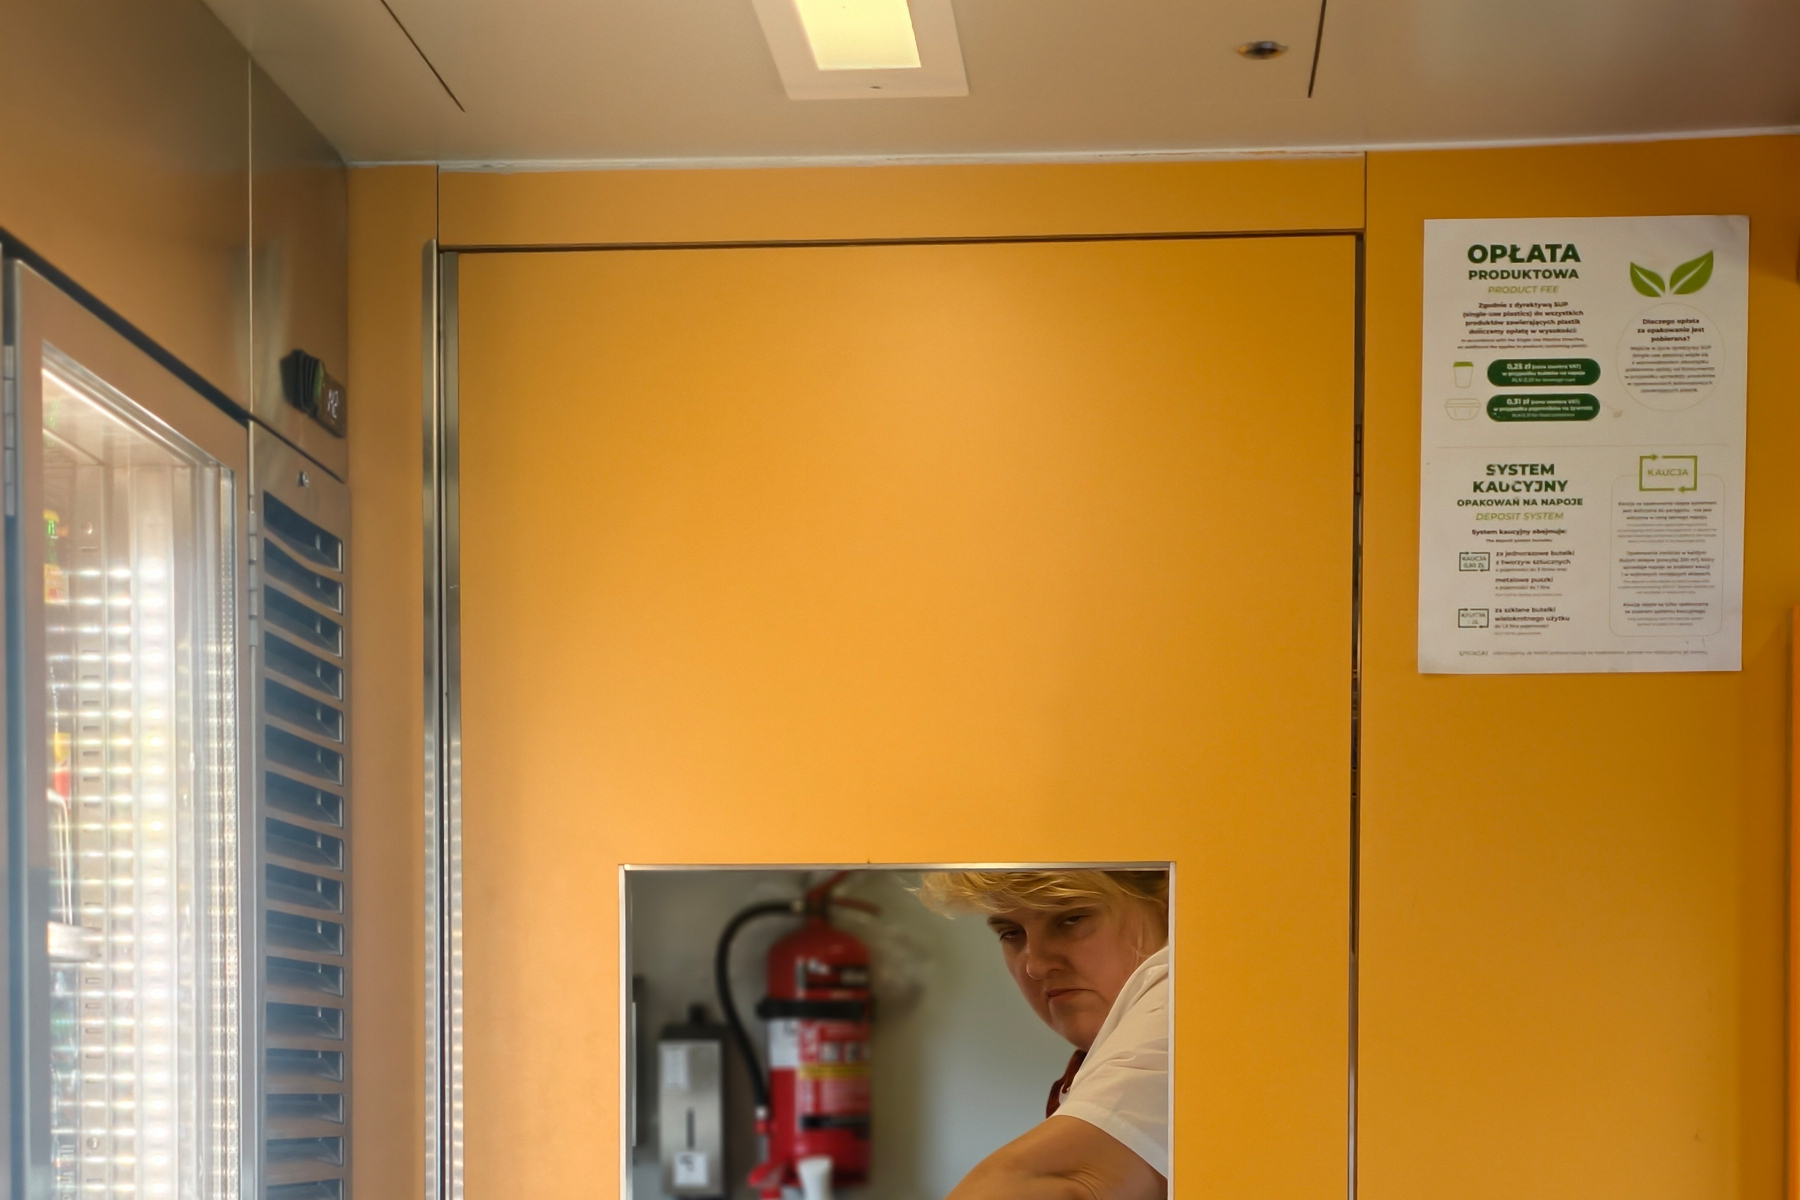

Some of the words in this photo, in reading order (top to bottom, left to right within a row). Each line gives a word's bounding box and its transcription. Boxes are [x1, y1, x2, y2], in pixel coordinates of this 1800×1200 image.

[1467, 244, 1581, 264] OPŁATA
[1468, 269, 1579, 280] PRODUKTOWA
[1488, 286, 1537, 294] PRODUCT
[1540, 285, 1559, 293] FEE
[1692, 326, 1704, 334] jest
[1486, 464, 1555, 476] SYSTEM
[1473, 480, 1568, 493] KAUCYJNY
[1457, 497, 1520, 507] OPAKOWAŃ
[1541, 498, 1583, 506] NAPOJE
[1476, 513, 1521, 521] DEPOSIT
[1524, 512, 1564, 520] SYSTEM
